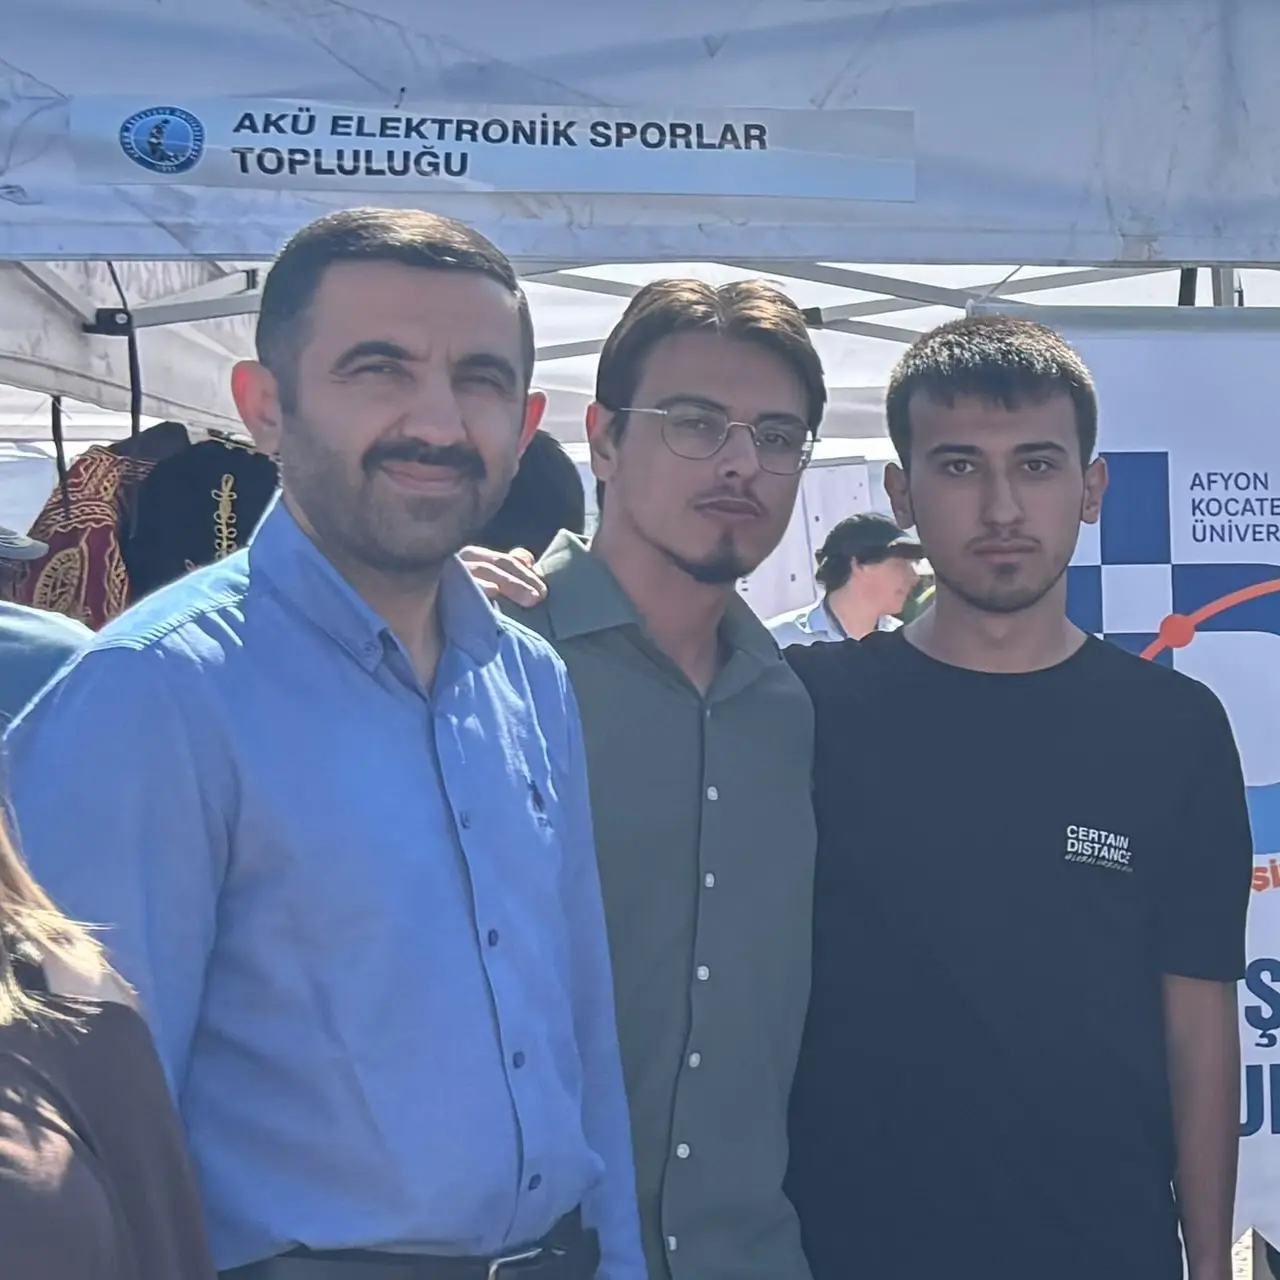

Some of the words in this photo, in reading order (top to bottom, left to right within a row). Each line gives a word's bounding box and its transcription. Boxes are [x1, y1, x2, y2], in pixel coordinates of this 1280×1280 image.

[233, 107, 316, 136] AKÜ
[330, 113, 578, 147] ELEKTRONİK
[589, 121, 768, 150] SPORLAR
[231, 144, 468, 177] TOPLULUĞU
[1190, 472, 1270, 492] AFYON
[1066, 825, 1130, 850] CERTAIN
